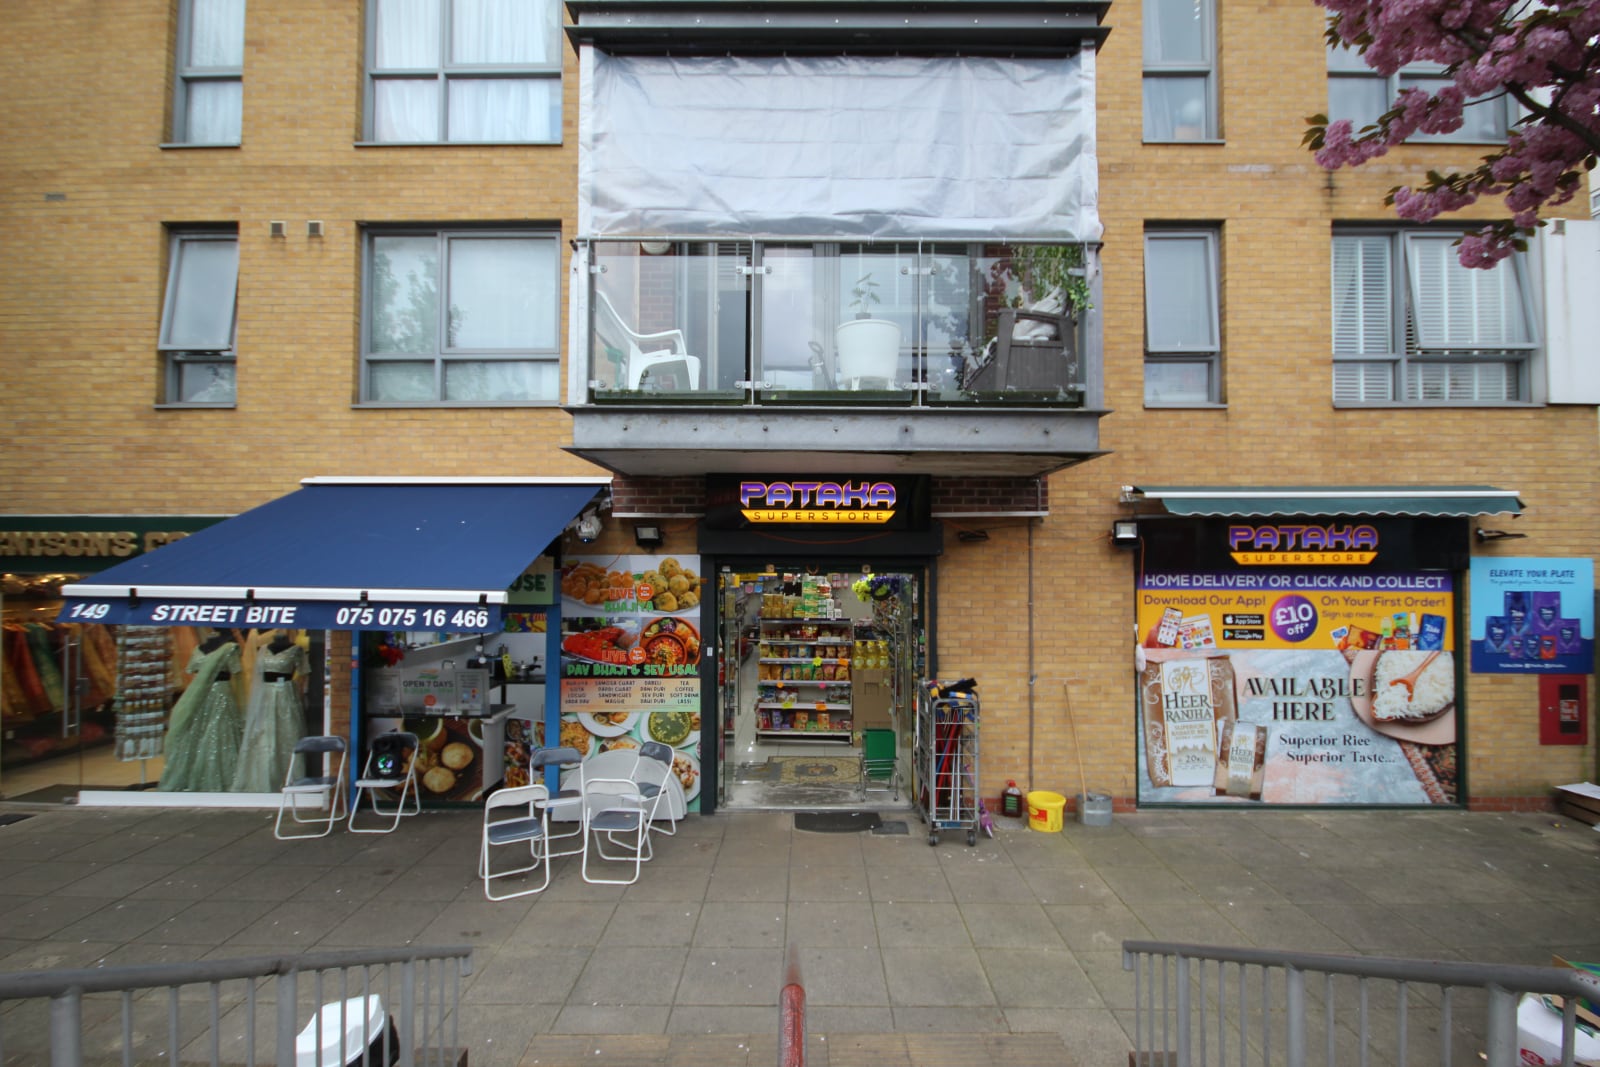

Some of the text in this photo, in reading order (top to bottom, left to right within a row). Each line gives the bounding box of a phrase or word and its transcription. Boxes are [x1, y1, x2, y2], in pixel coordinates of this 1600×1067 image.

[740, 480, 896, 508] PATAKA
[754, 512, 884, 520] SUPERSTORE
[1229, 524, 1378, 551] PATAKA
[1242, 554, 1366, 562] SUPERSTORE
[1145, 574, 1444, 588] HOME DELIVERY OR CLICK AND COLLECT
[1526, 570, 1547, 578] YOUR
[1550, 570, 1575, 578] PLATE
[1144, 595, 1266, 607] Download Our App!
[1321, 596, 1446, 607] On Your First Order!
[70, 604, 488, 627] 149 STREET BITE 075 075 16 466
[1275, 604, 1313, 626] £10
[593, 664, 627, 675] BHAJI
[644, 664, 665, 675] SEV
[669, 664, 698, 675] USAL
[1242, 677, 1365, 699] AVAILABLE
[1164, 692, 1212, 709] HEER
[1272, 702, 1336, 720] HERE
[1280, 734, 1370, 747] Superior Rice
[1286, 751, 1346, 765] Superior
